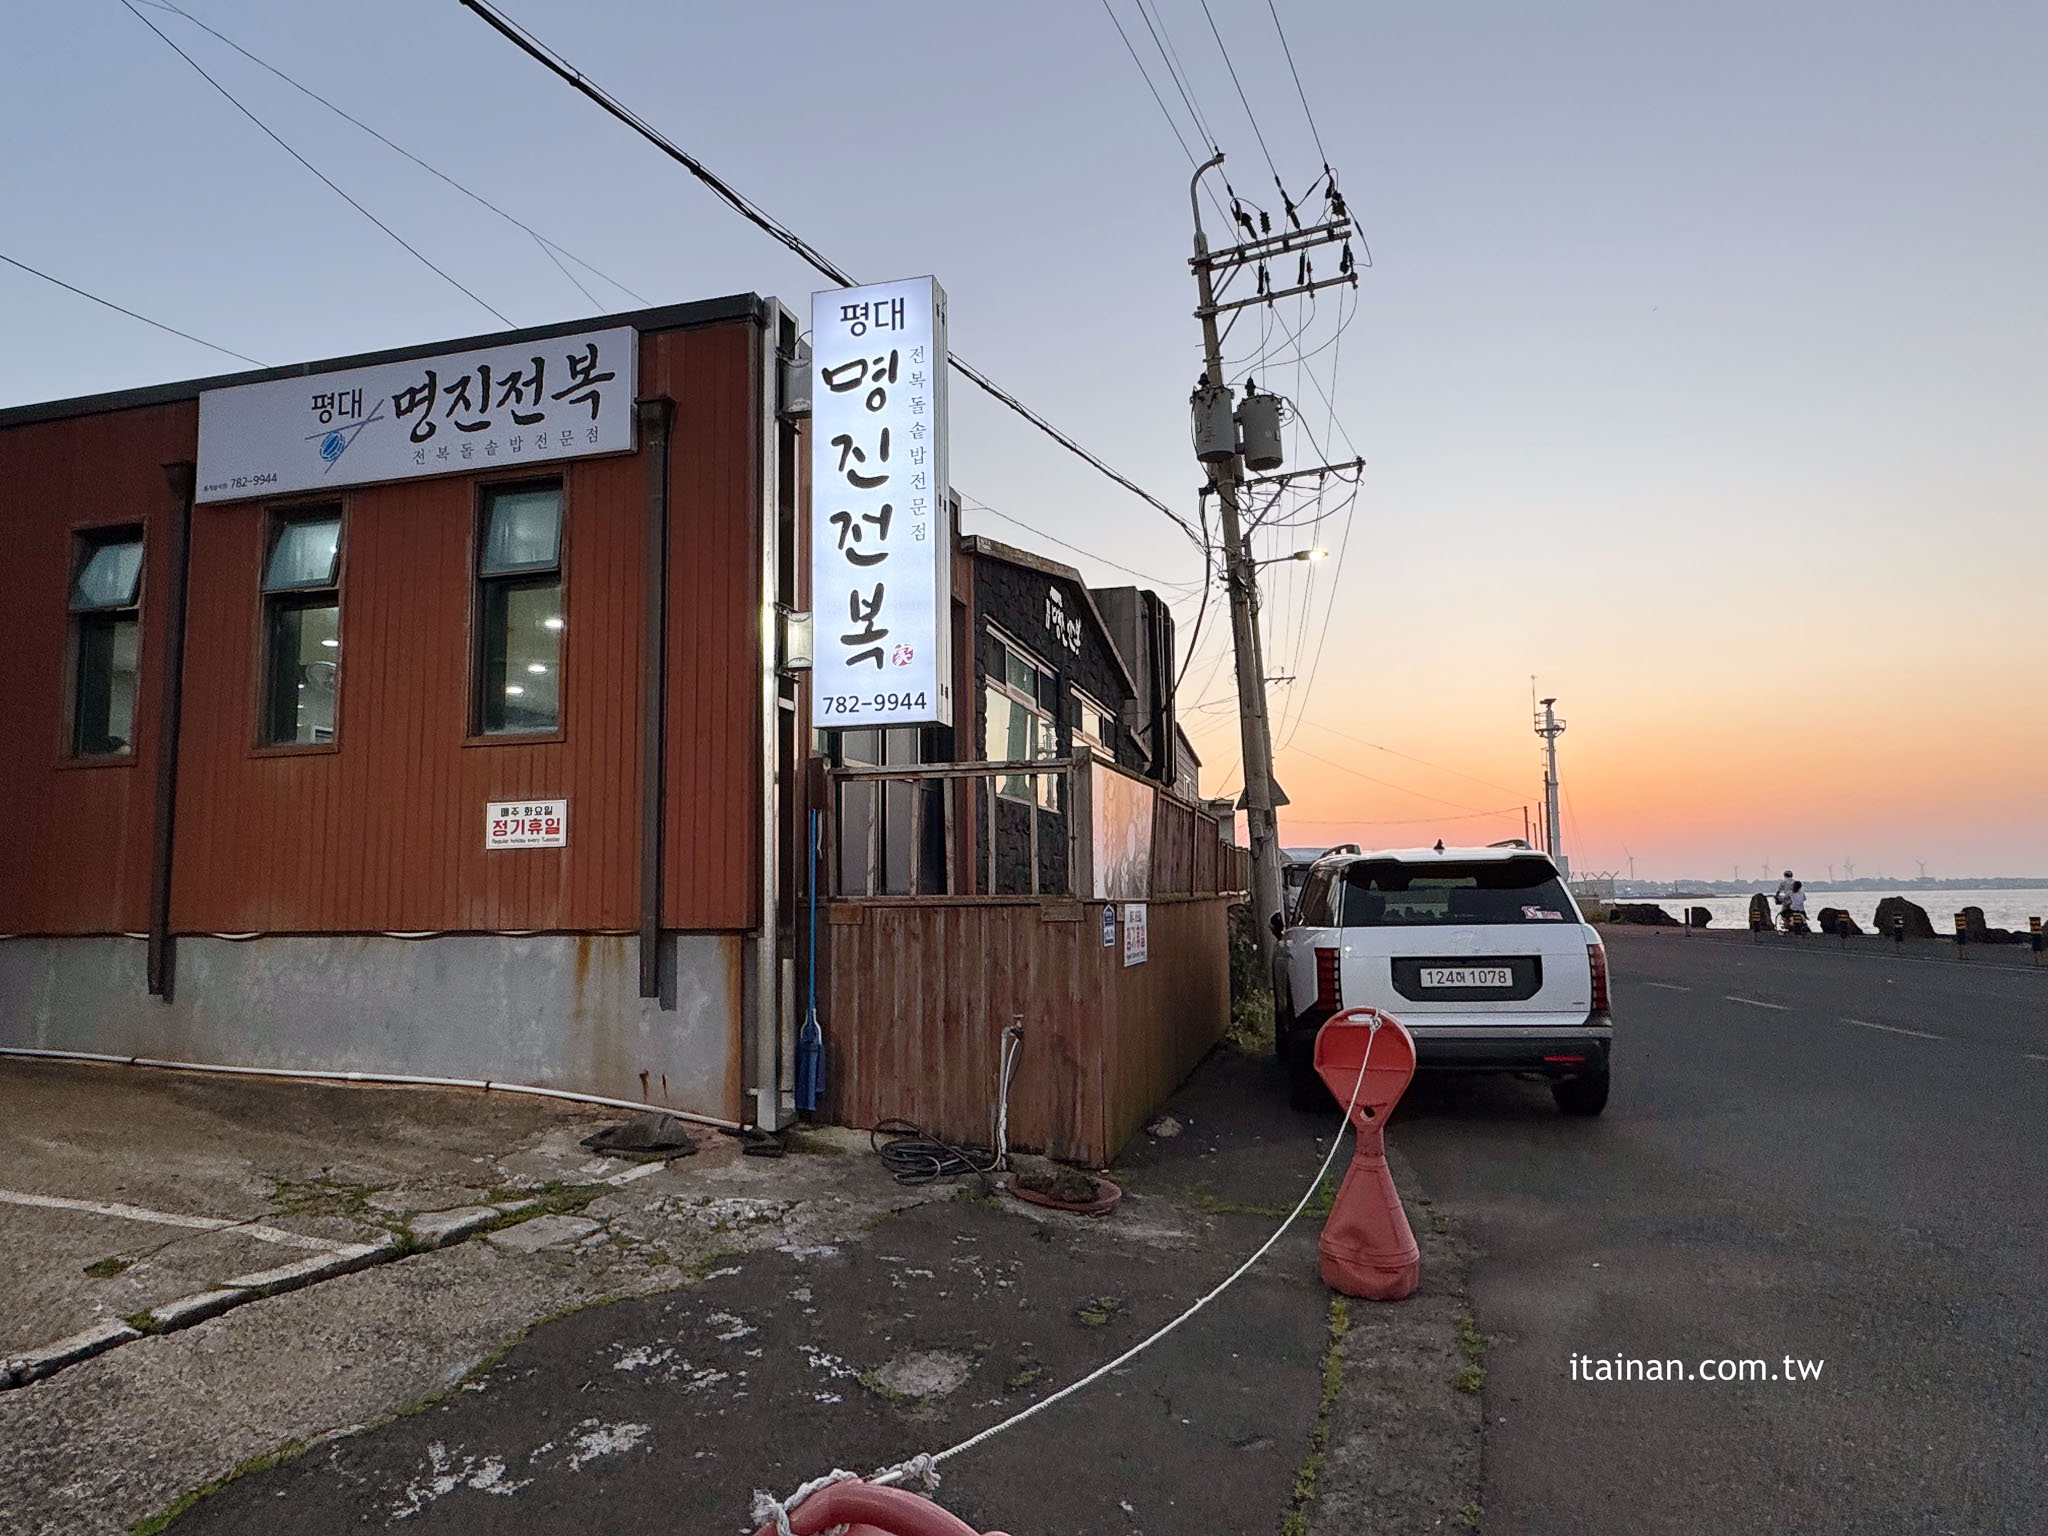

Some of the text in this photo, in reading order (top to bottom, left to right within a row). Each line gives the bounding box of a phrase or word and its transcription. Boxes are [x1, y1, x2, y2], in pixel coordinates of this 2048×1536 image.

[840, 297, 905, 337] 평대
[311, 388, 363, 424] 평대
[392, 343, 616, 444] 명진전복
[231, 473, 278, 489] 782-9944
[822, 349, 899, 670] 명진전복
[822, 692, 927, 714] 782-9944
[524, 805, 553, 817] 화요일
[492, 818, 561, 837] 정기휴일
